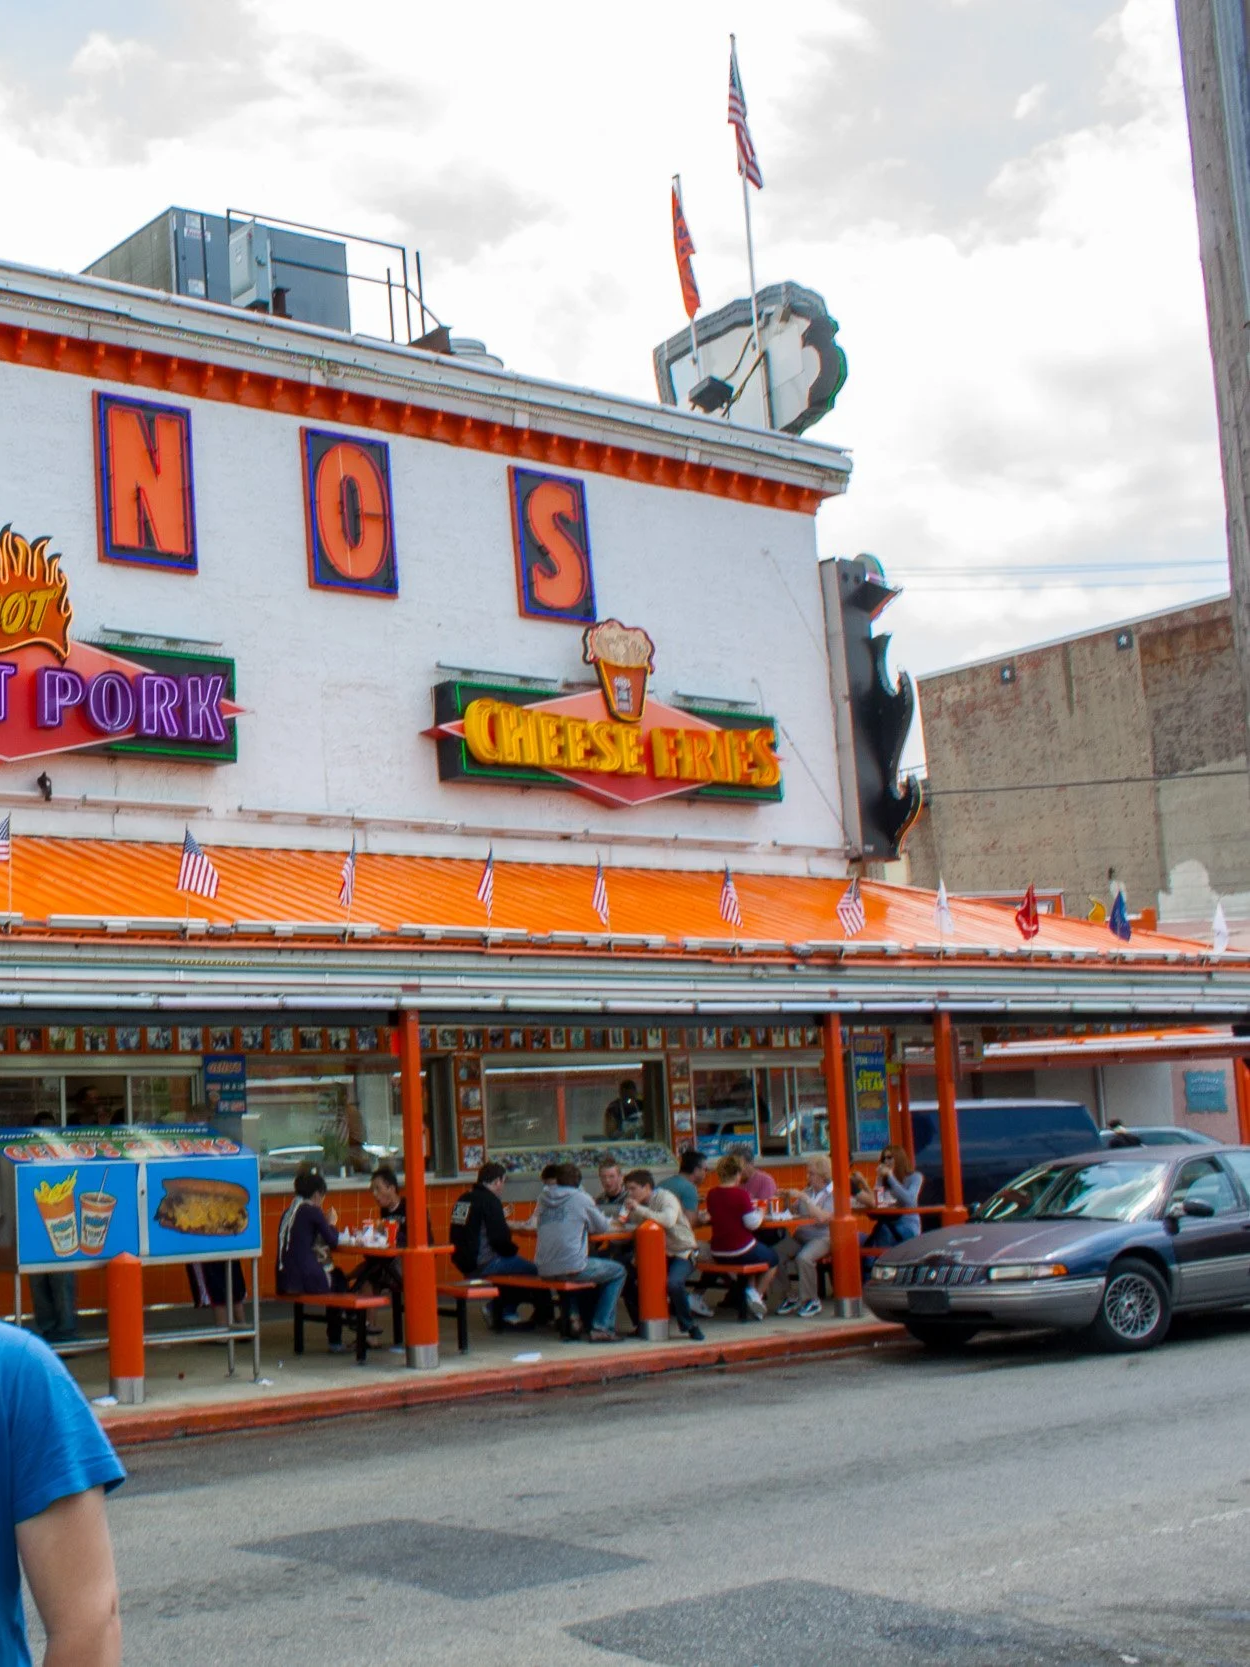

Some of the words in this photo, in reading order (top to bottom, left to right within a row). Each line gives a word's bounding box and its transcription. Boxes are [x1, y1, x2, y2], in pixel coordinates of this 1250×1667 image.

[37, 666, 227, 744] PORK
[464, 697, 647, 775] CHEESE
[650, 726, 781, 788] FRIES
